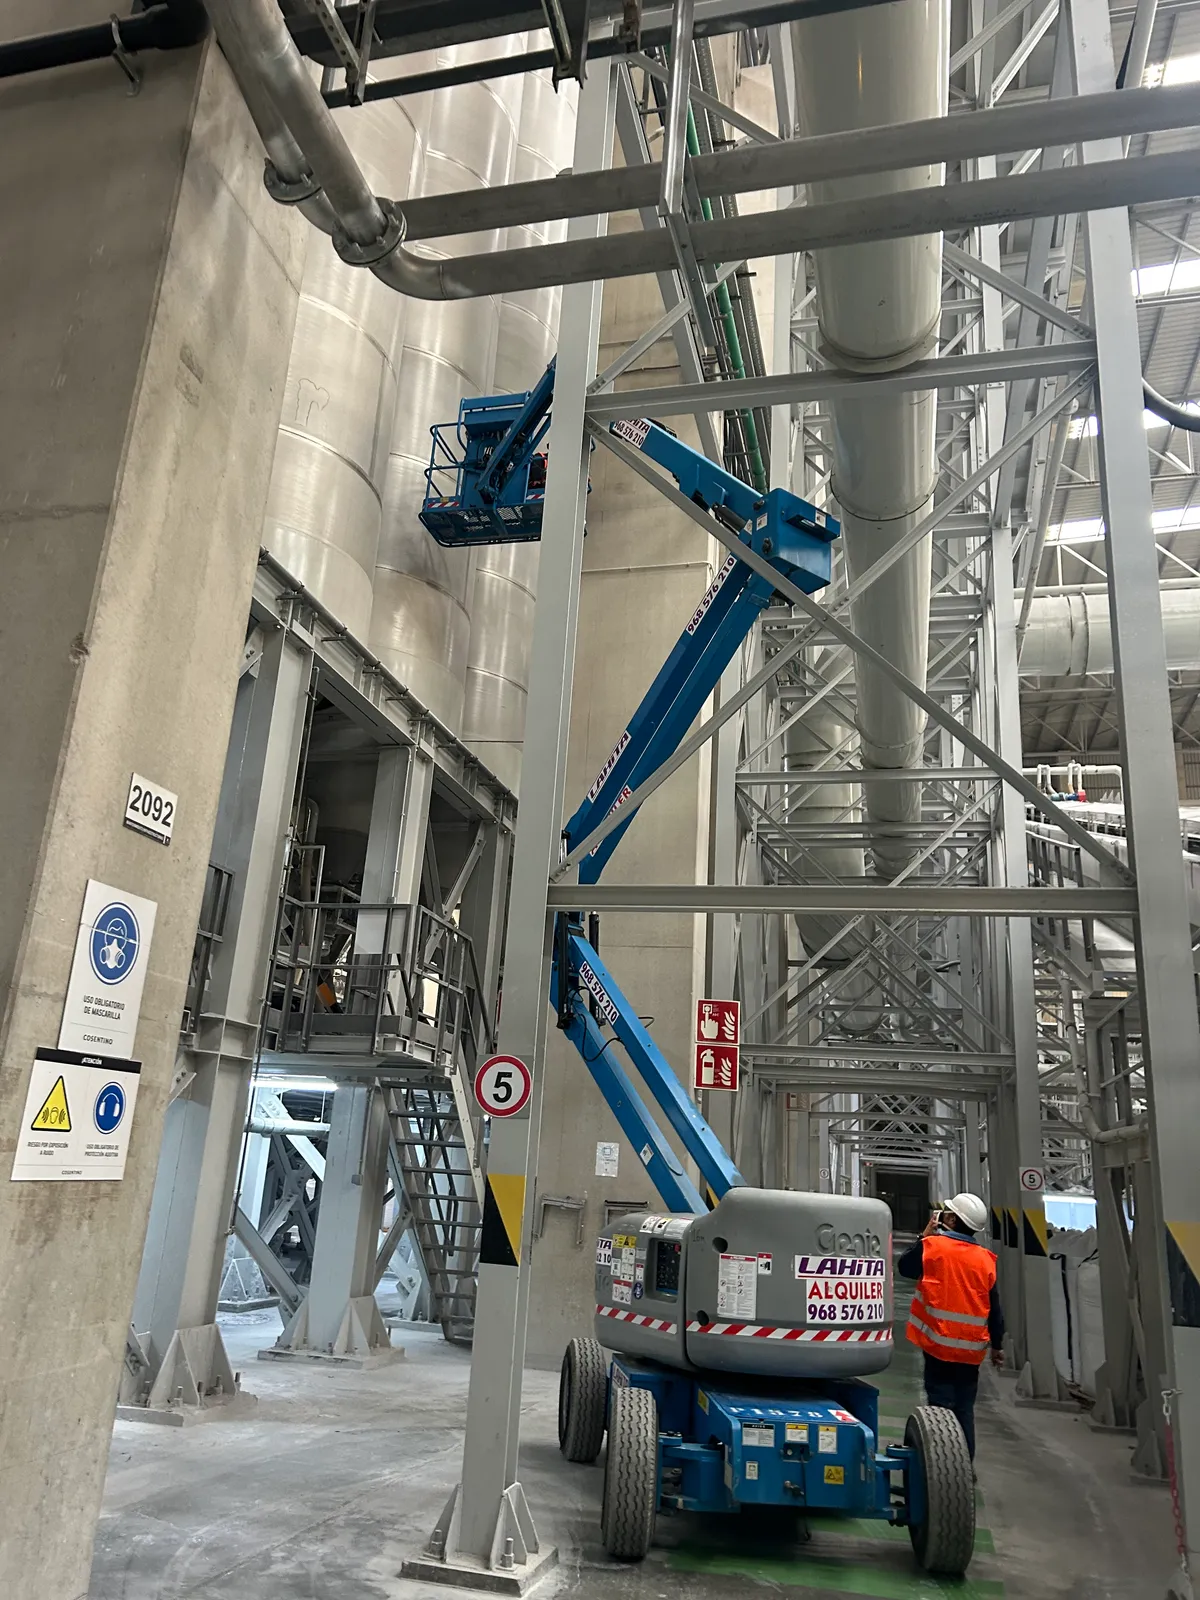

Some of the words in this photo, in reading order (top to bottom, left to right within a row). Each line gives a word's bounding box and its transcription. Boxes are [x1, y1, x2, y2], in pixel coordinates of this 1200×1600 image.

[622, 426, 634, 439] 576
[632, 433, 645, 446] 210
[687, 608, 704, 632] 968
[702, 584, 719, 609] 576
[718, 557, 735, 582] 210
[129, 784, 174, 828] 2092
[580, 963, 595, 985] 968
[591, 981, 605, 1003] 576
[602, 999, 618, 1022] 210
[83, 995, 94, 1004] USO
[94, 997, 126, 1011] OBLIGATORIO
[83, 1006, 91, 1015] DE
[91, 1008, 121, 1020] MASCARILLA
[83, 1034, 113, 1045] COSENTINO
[492, 1071, 513, 1104] 5
[1028, 1174, 1036, 1184] 5
[815, 1223, 881, 1258] Genie
[807, 1280, 883, 1300] ALQUILER
[807, 1303, 837, 1321] 968
[840, 1304, 864, 1321] 576
[867, 1303, 883, 1320] 210
